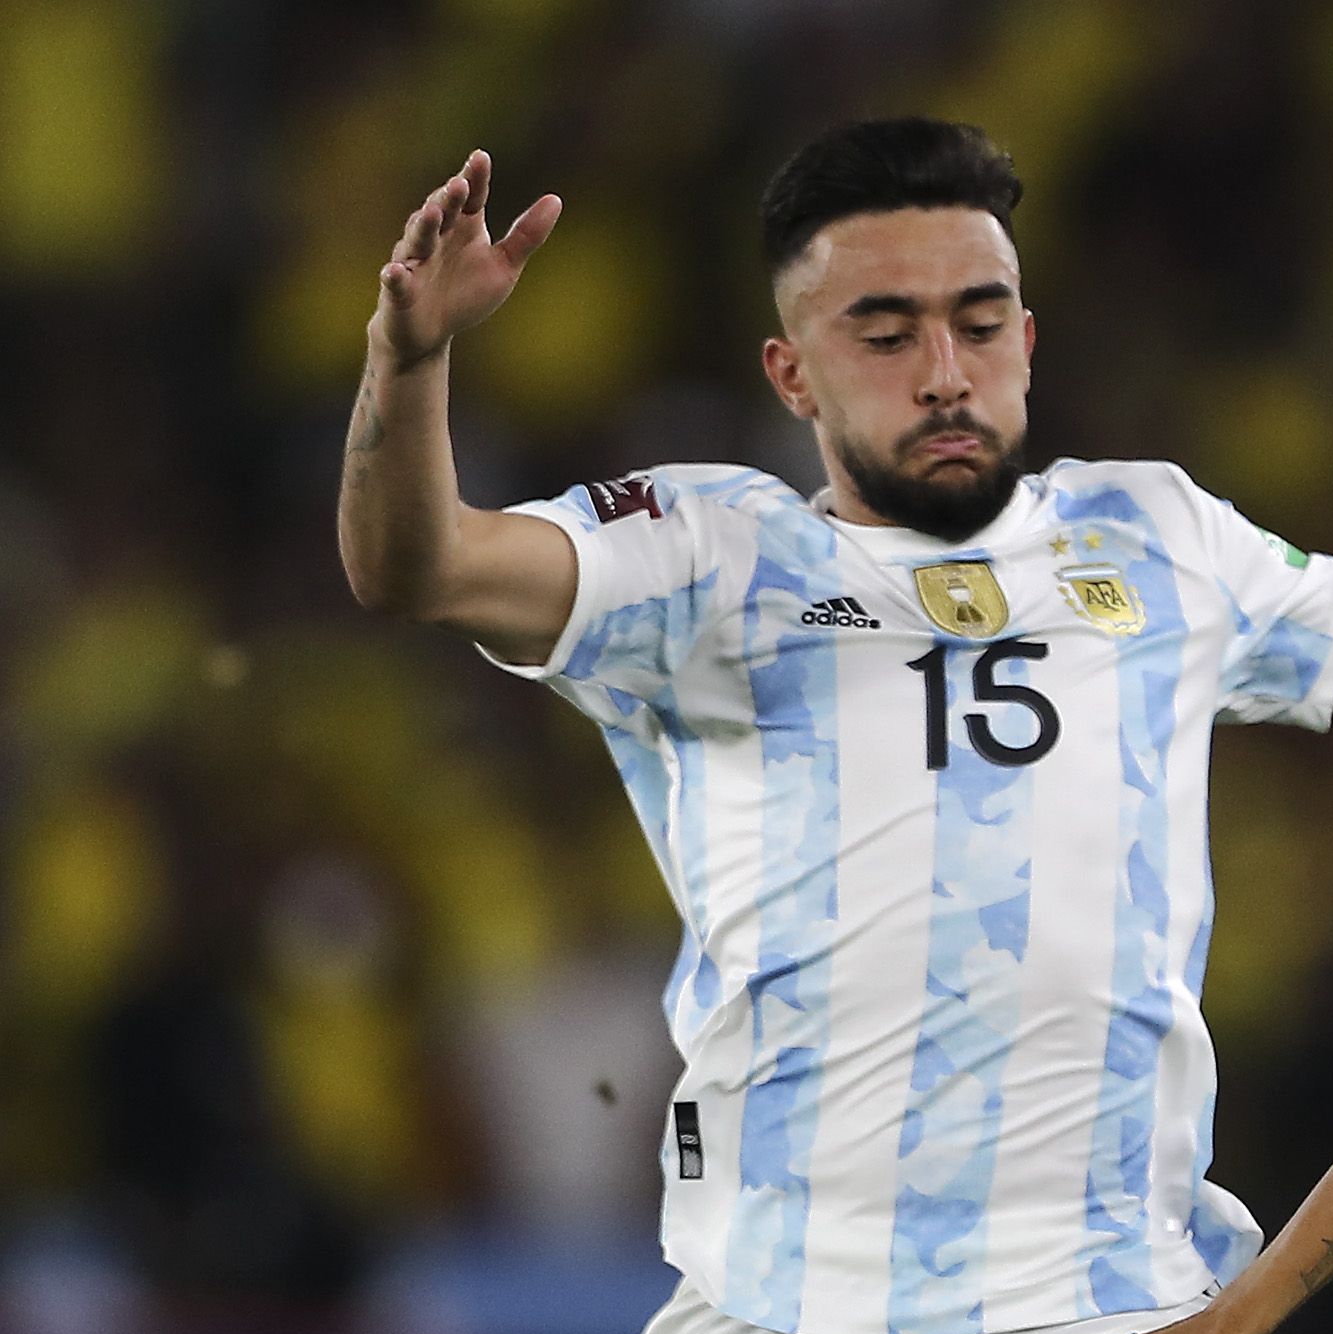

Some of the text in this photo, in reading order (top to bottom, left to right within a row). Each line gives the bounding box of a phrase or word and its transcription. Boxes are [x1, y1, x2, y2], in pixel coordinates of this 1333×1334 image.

[1086, 580, 1129, 612] AFA
[801, 609, 881, 629] adidas
[906, 636, 1061, 771] 15
